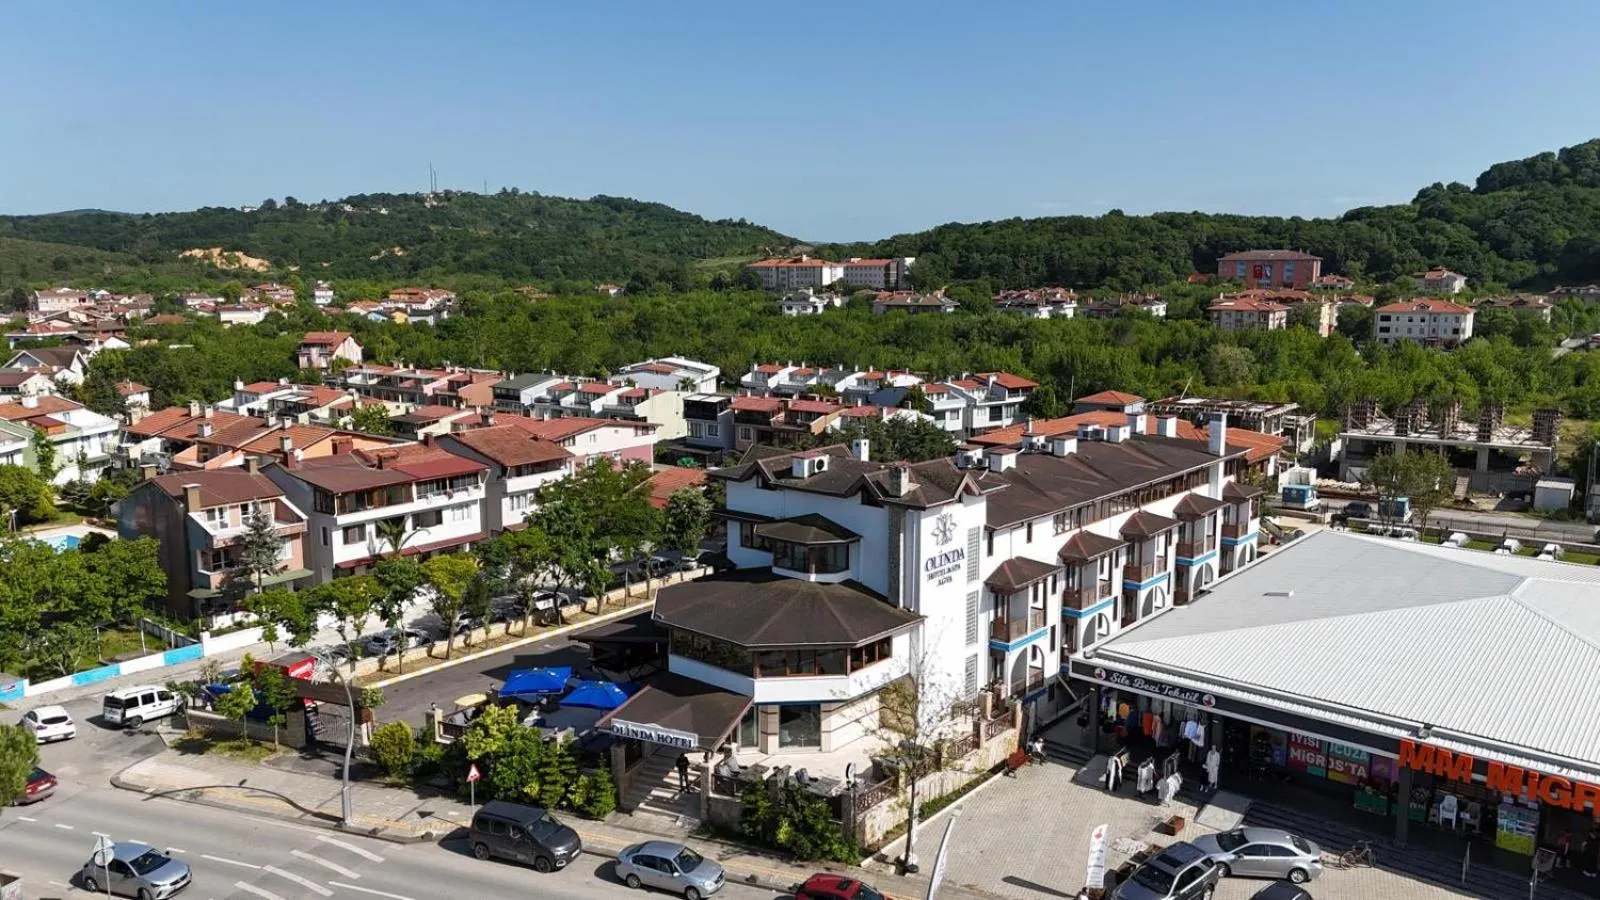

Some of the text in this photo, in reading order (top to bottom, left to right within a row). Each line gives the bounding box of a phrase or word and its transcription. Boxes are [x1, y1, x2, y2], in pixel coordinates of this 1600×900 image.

[1132, 678, 1160, 694] Bezi
[1160, 685, 1200, 702] Tekstil
[1398, 737, 1474, 784] MM
